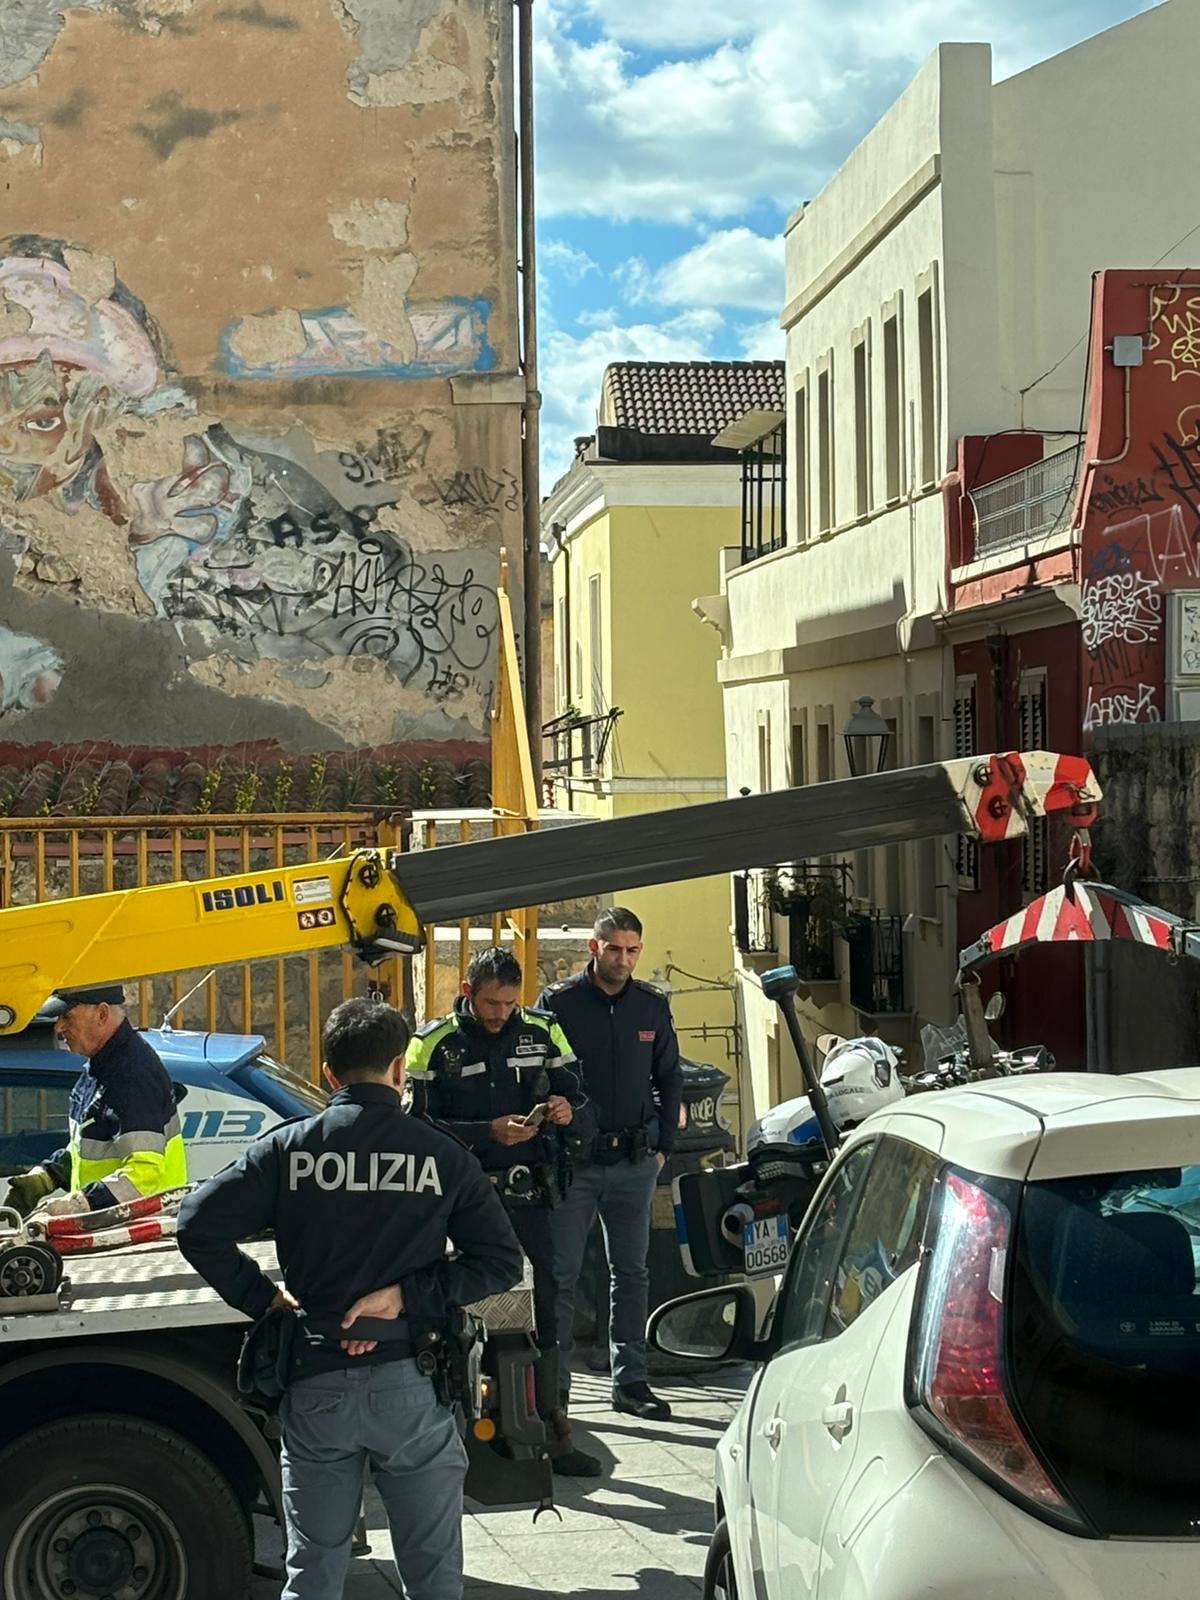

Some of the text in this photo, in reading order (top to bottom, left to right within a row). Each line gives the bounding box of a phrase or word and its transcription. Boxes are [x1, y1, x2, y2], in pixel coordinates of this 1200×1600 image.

[202, 881, 284, 912] ISOLI
[182, 1110, 266, 1138] 113
[289, 1151, 443, 1196] POLIZIA
[754, 1221, 770, 1240] YA
[746, 1244, 787, 1269] 00568
